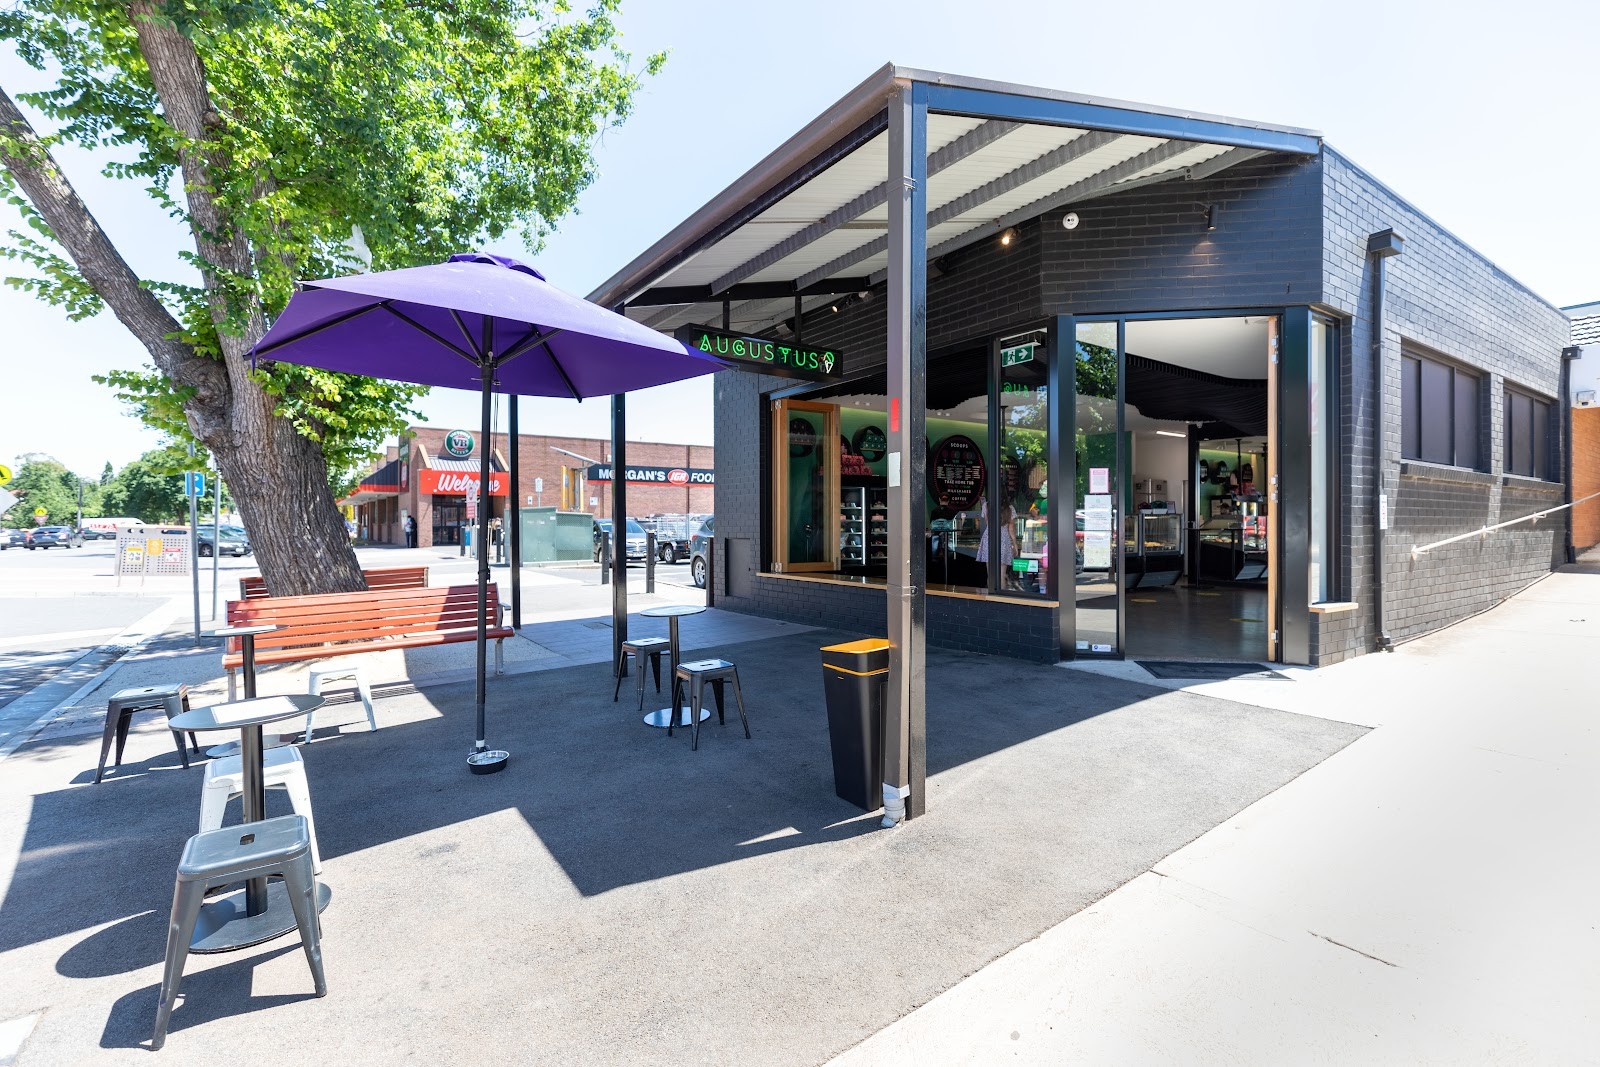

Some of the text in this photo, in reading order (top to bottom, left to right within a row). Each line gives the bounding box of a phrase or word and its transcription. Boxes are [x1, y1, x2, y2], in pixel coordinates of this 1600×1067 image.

[700, 334, 819, 369] AUGUSTUS
[453, 439, 468, 447] VB
[598, 468, 714, 482] MOGAN'S IGA FOO
